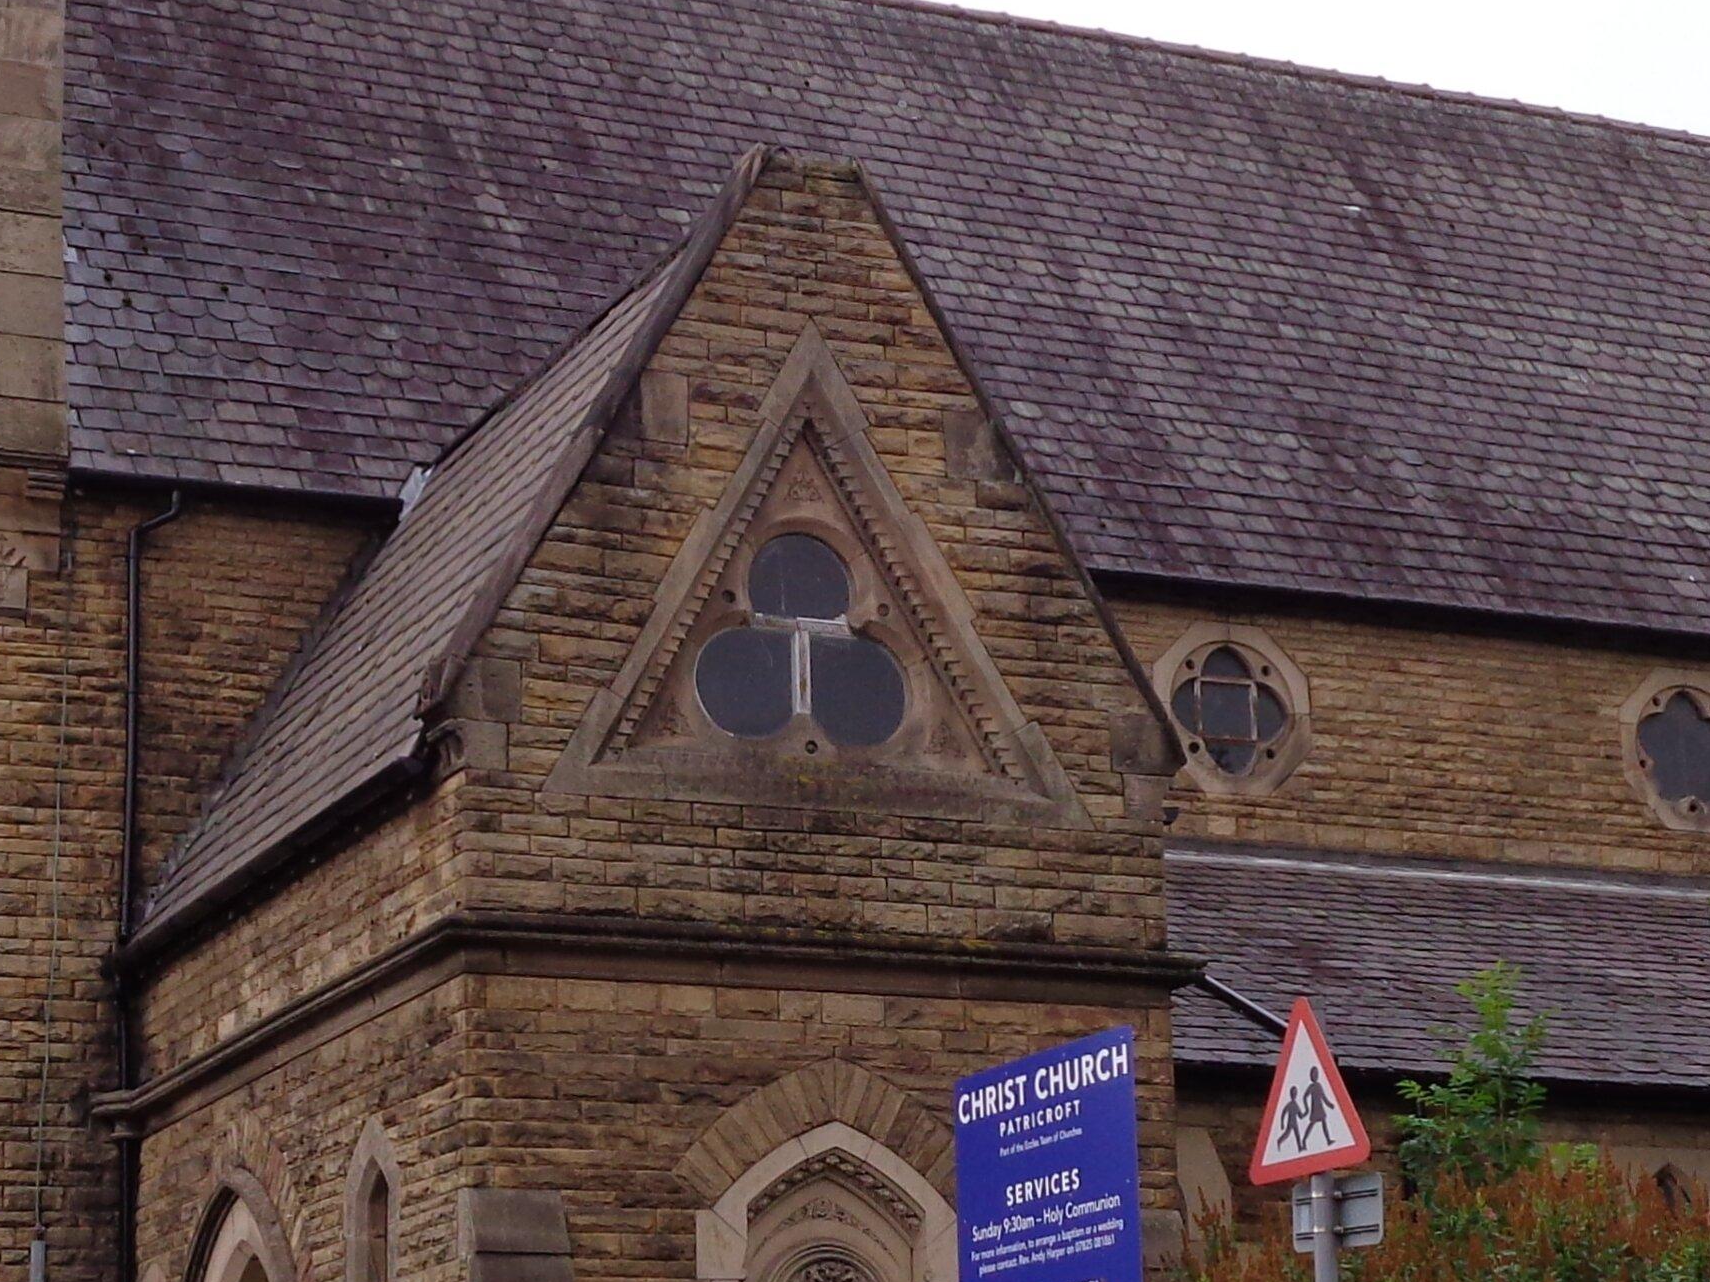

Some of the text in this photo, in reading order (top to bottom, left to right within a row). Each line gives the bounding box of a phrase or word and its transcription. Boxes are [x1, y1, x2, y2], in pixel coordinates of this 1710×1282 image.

[958, 1043, 1129, 1124] CHRIST CHURCH
[999, 1099, 1081, 1137] PATRICROFT
[1006, 1168, 1080, 1207] SERVICES
[972, 1221, 1002, 1242] Sunday
[1003, 1215, 1035, 1234] 9:30am
[1043, 1205, 1064, 1225] Holy
[1065, 1193, 1121, 1218] Communion
[971, 1251, 980, 1261] For
[981, 1249, 995, 1259] more
[1028, 1239, 1035, 1248] to
[1035, 1234, 1057, 1247] arrange
[1061, 1228, 1085, 1242] baptism
[1085, 1226, 1092, 1235] or
[1097, 1217, 1124, 1231] wedding
[978, 1262, 996, 1278] please
[1031, 1248, 1046, 1264] Andy
[1046, 1248, 1066, 1260] Harper
[1066, 1245, 1075, 1255] on
